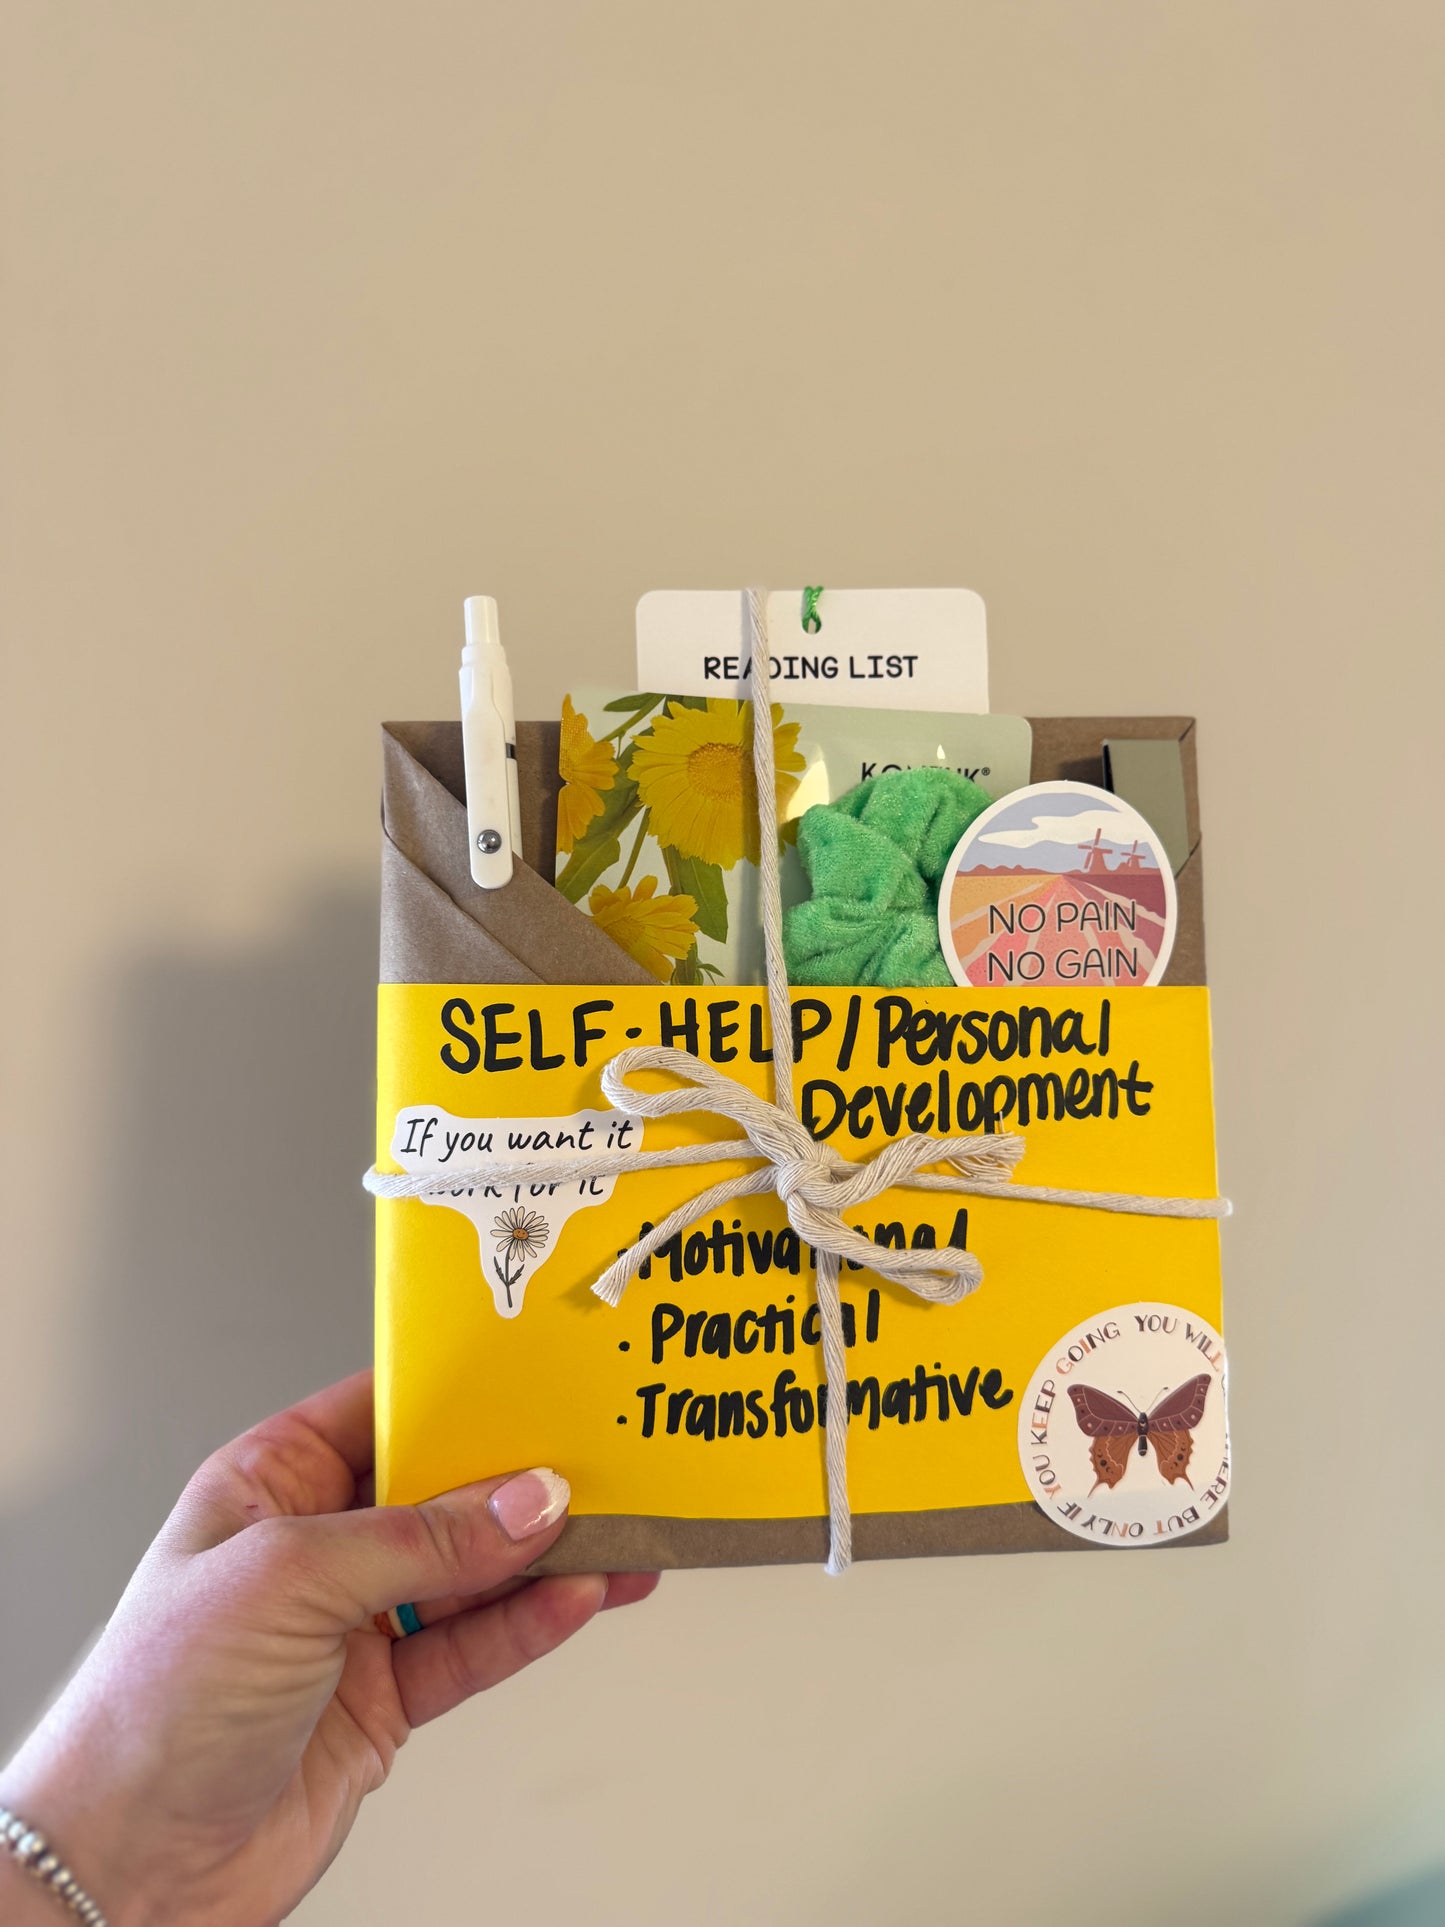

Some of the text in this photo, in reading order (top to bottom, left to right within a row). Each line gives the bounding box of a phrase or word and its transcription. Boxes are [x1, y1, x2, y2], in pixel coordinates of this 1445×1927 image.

[849, 655, 919, 679] LIST
[989, 901, 1136, 934] NO PAIN
[988, 947, 1138, 982] NO GAIN
[801, 1060, 1155, 1141] Development
[400, 1117, 634, 1162] If you want it
[638, 1208, 968, 1283] Motivanal
[1134, 1314, 1178, 1335] YOU
[1055, 1321, 1121, 1376] GOING
[1185, 1322, 1223, 1373] WILL
[1030, 1379, 1057, 1446] KEEP
[1032, 1454, 1062, 1500] YOU
[1056, 1501, 1083, 1521] IF
[1080, 1514, 1144, 1538] ONLY
[1153, 1505, 1201, 1536] BUT
